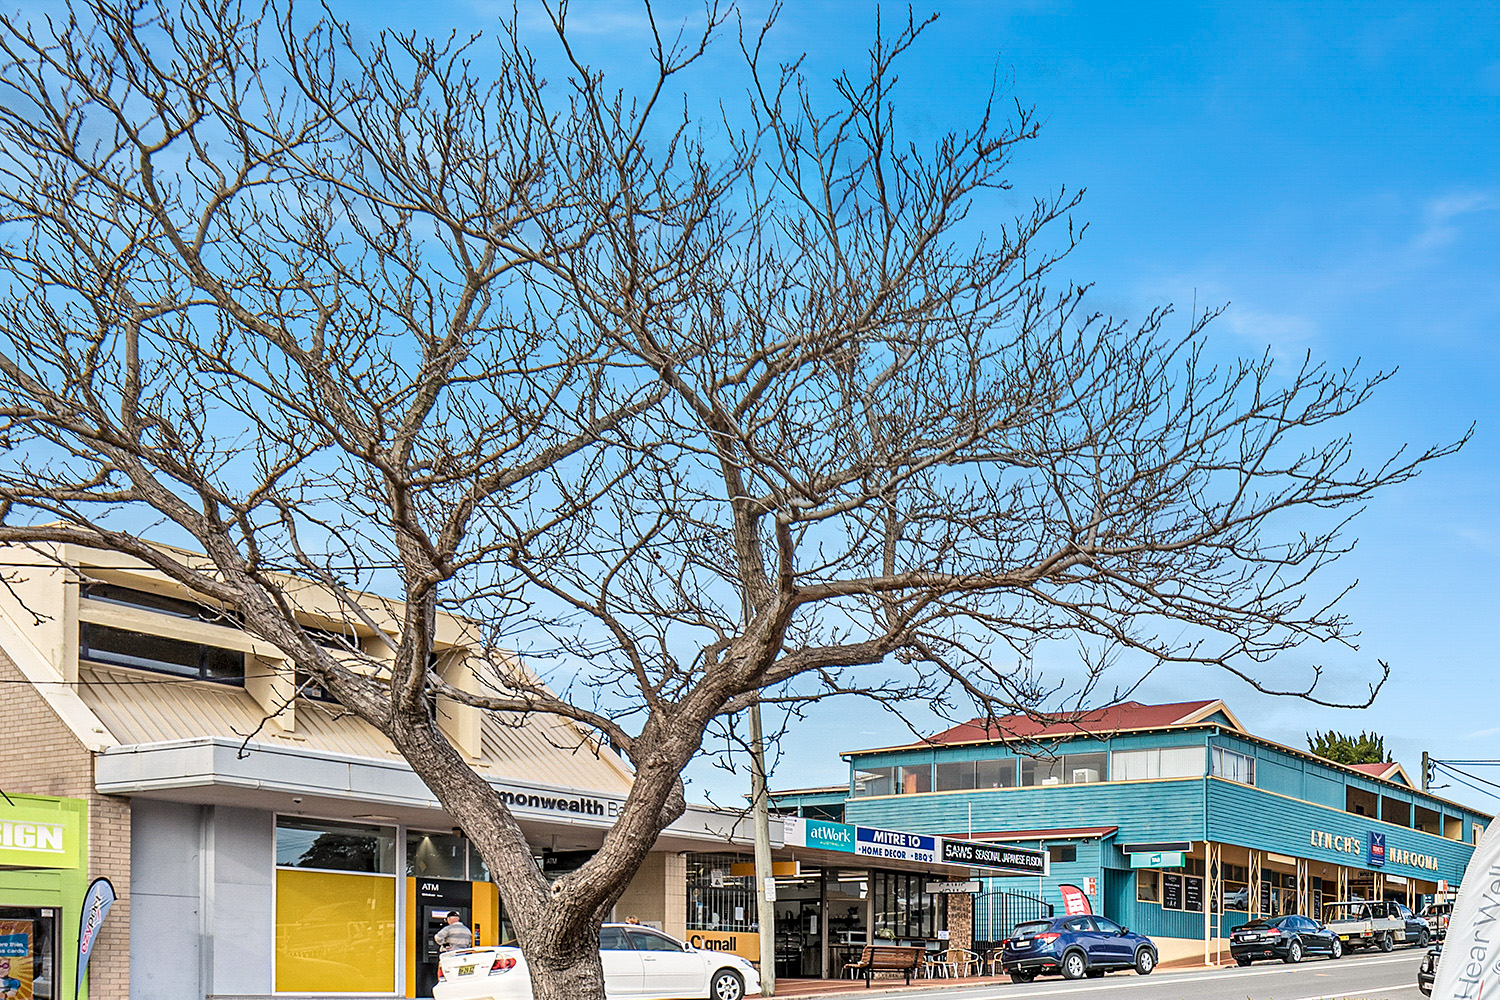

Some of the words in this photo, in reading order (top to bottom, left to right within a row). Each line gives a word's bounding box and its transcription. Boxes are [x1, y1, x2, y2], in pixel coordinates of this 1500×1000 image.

[0, 823, 63, 850] IGN
[810, 826, 851, 843] atWork
[873, 830, 906, 846] MITRE
[908, 835, 921, 848] 10
[1310, 829, 1361, 856] LYNCH'S
[861, 845, 883, 856] HOME
[884, 849, 906, 860] DECOR
[945, 844, 973, 860] SAWS
[1389, 847, 1438, 871] NAROOMA
[421, 883, 439, 891] ATM
[690, 935, 737, 952] Cignall
